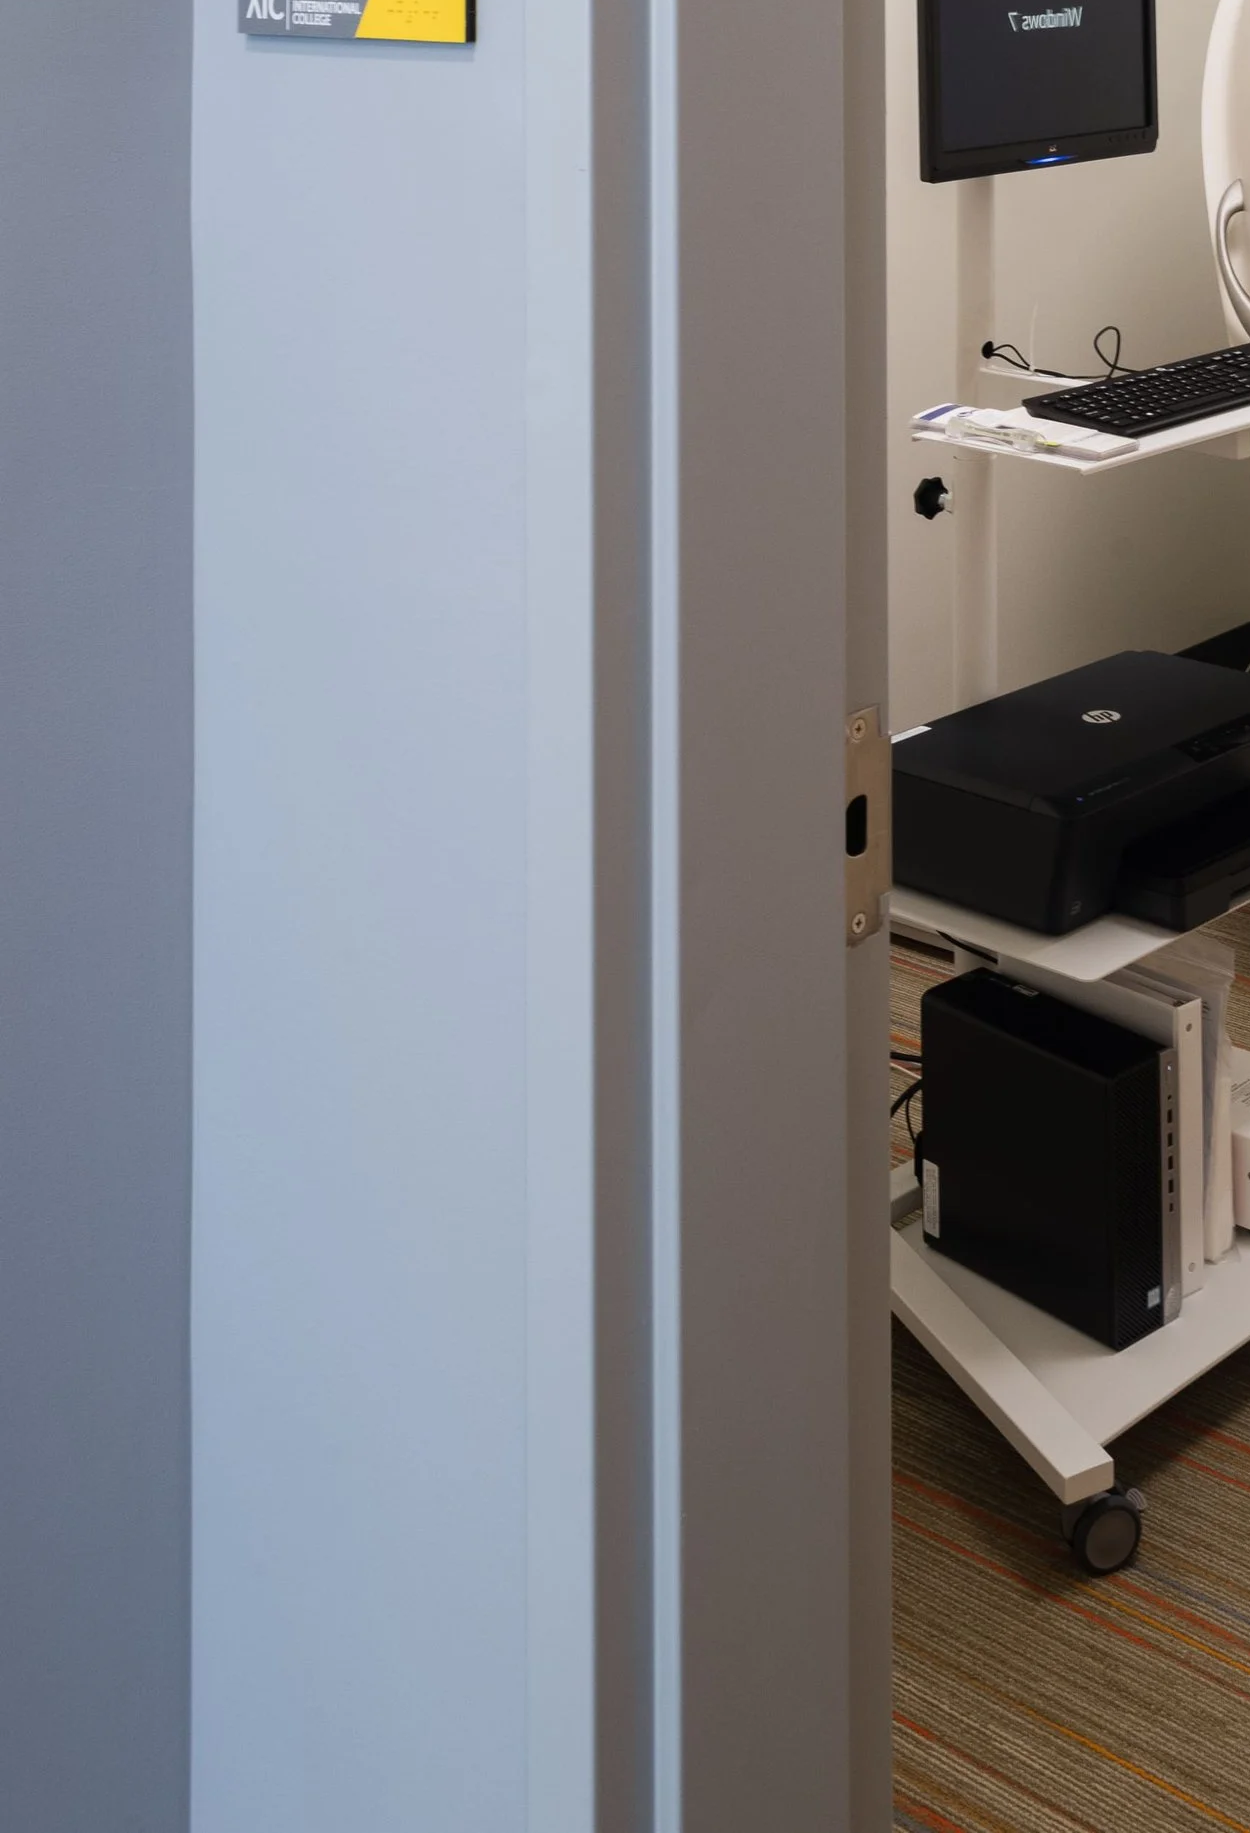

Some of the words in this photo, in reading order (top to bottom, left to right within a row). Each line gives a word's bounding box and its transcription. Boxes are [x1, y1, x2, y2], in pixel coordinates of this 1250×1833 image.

[292, 0, 361, 14] INTERNATIONAL
[292, 13, 332, 26] COLLEGE
[1083, 710, 1119, 723] hp
